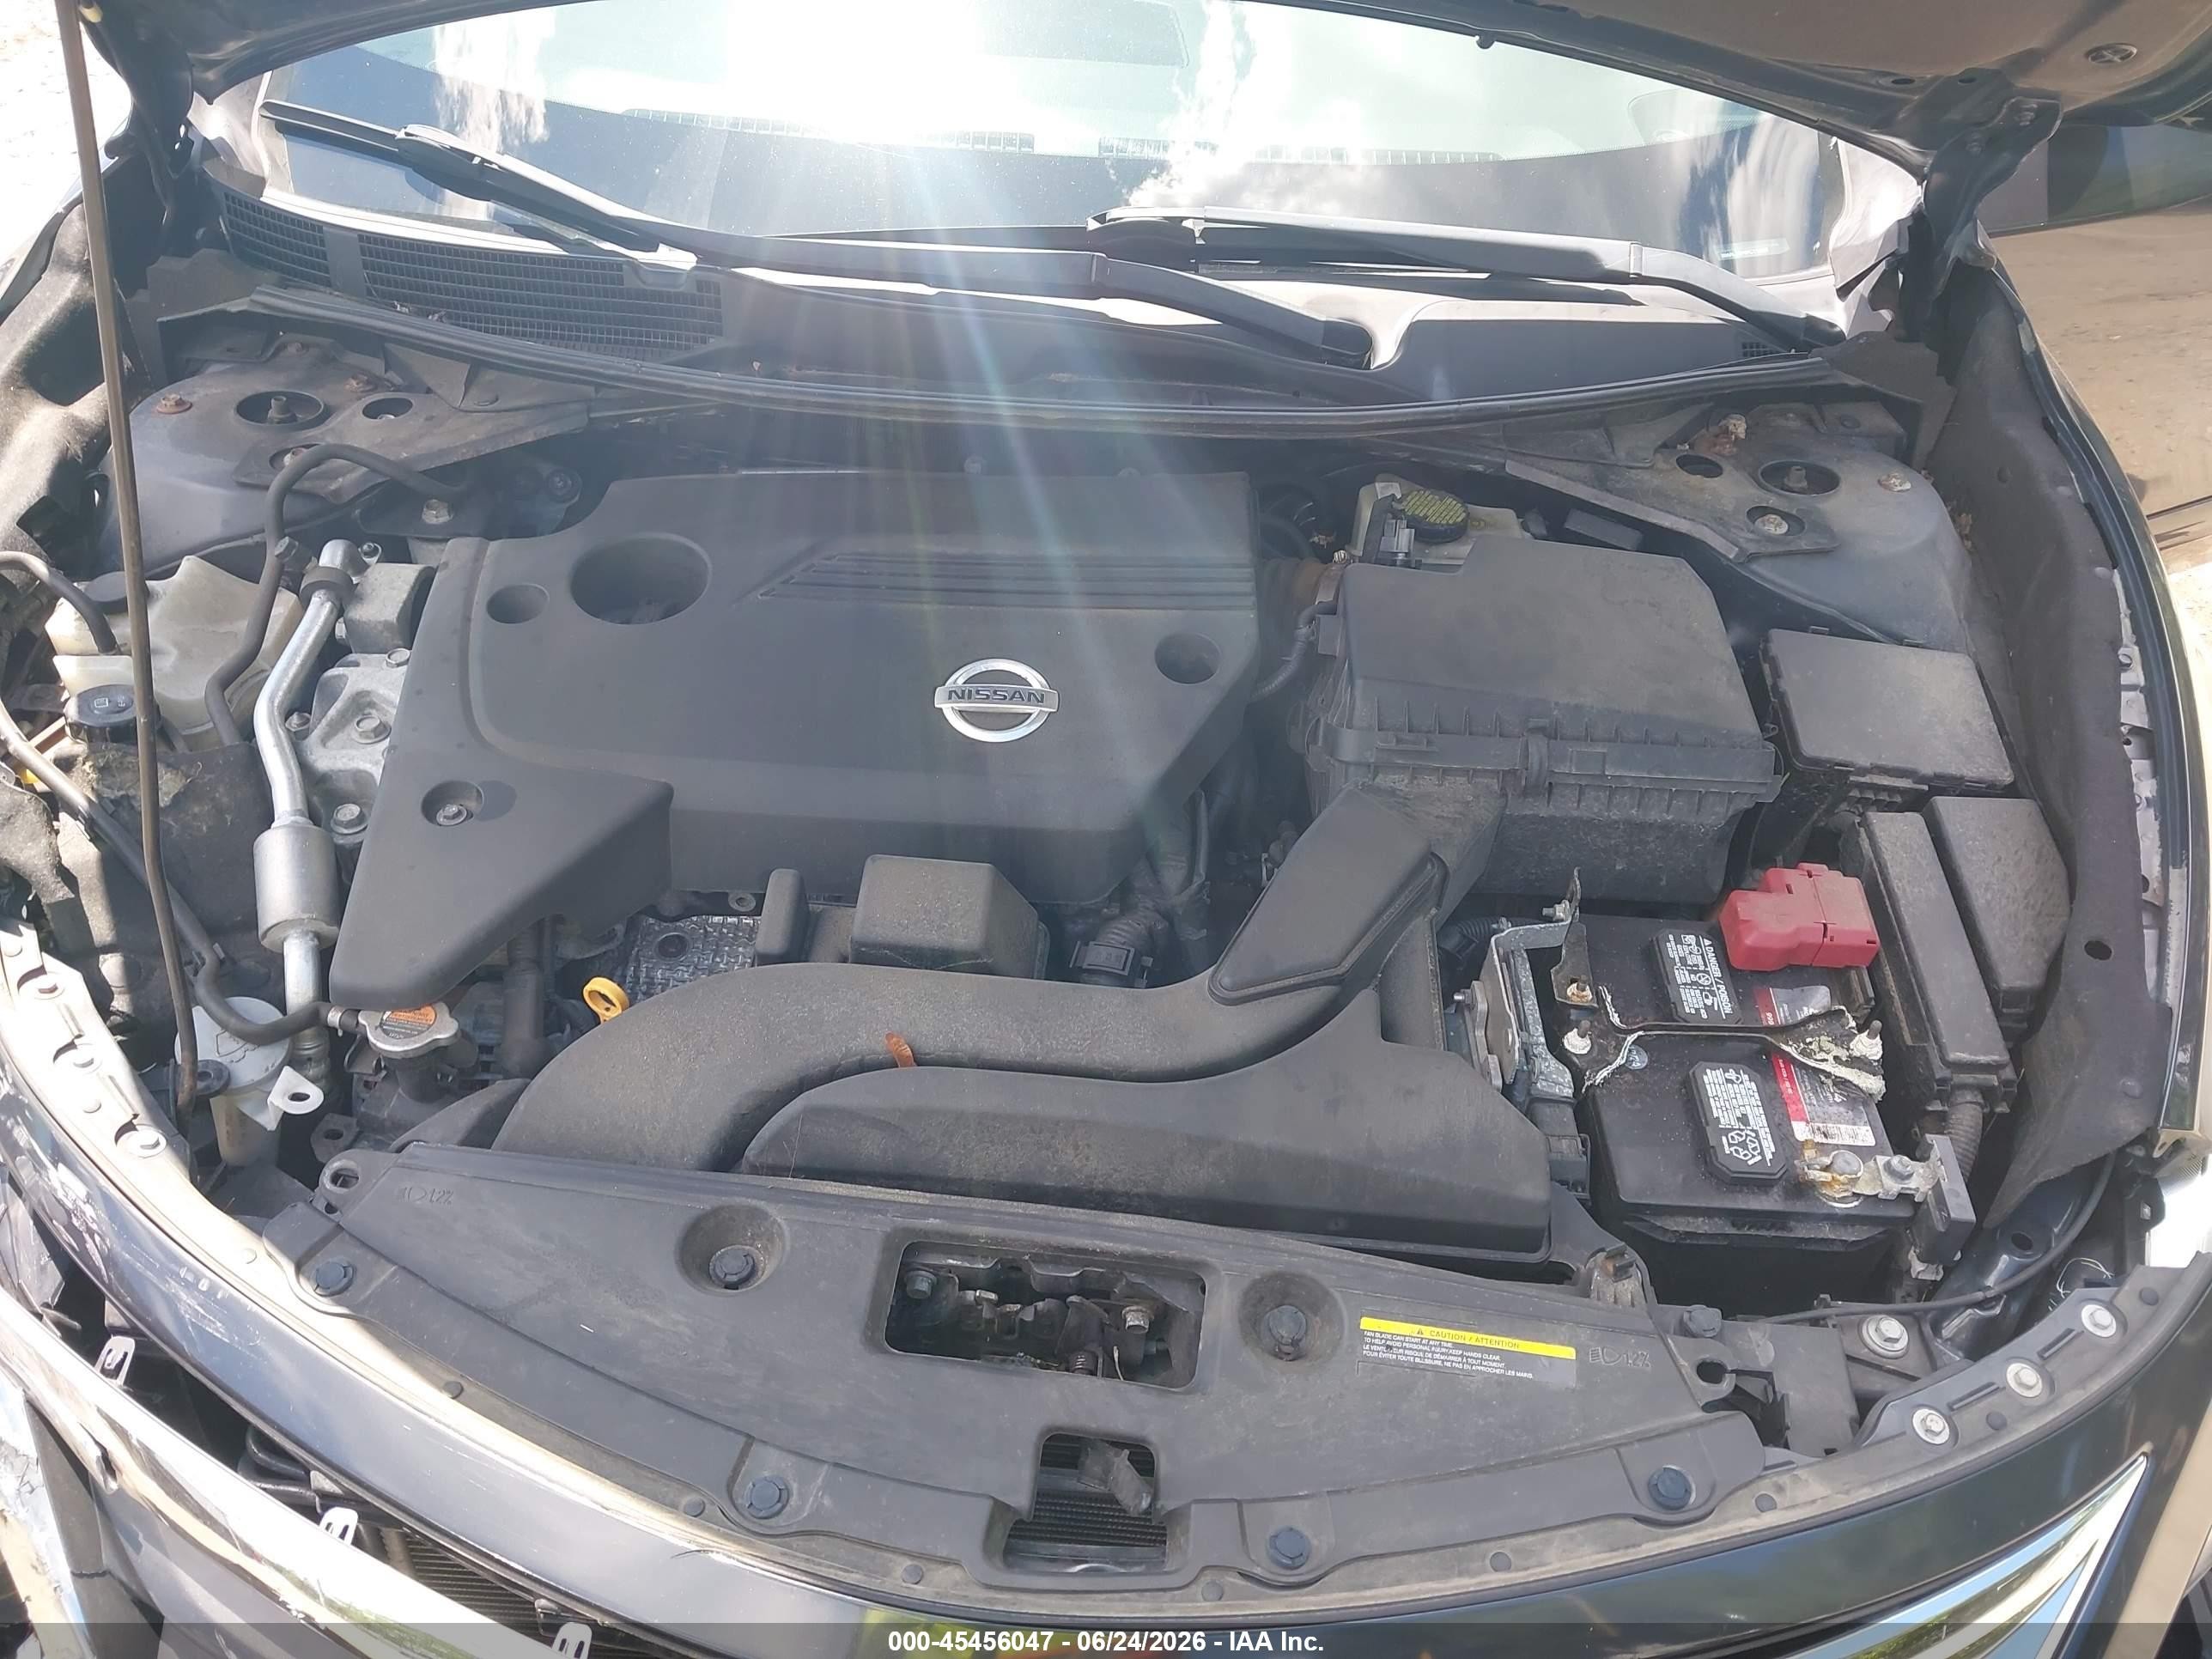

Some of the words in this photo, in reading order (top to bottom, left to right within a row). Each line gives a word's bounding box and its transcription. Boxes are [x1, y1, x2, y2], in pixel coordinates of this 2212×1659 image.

[947, 689, 1045, 703] NISSAN
[1705, 947, 1722, 977] DANGER
[1717, 985, 1733, 1014] POISON
[1402, 1342, 1431, 1351] PERSONAL
[1429, 1330, 1466, 1340] CAUTION
[1475, 1336, 1520, 1349] ATTENTION
[1472, 1365, 1504, 1375] APPROCHER
